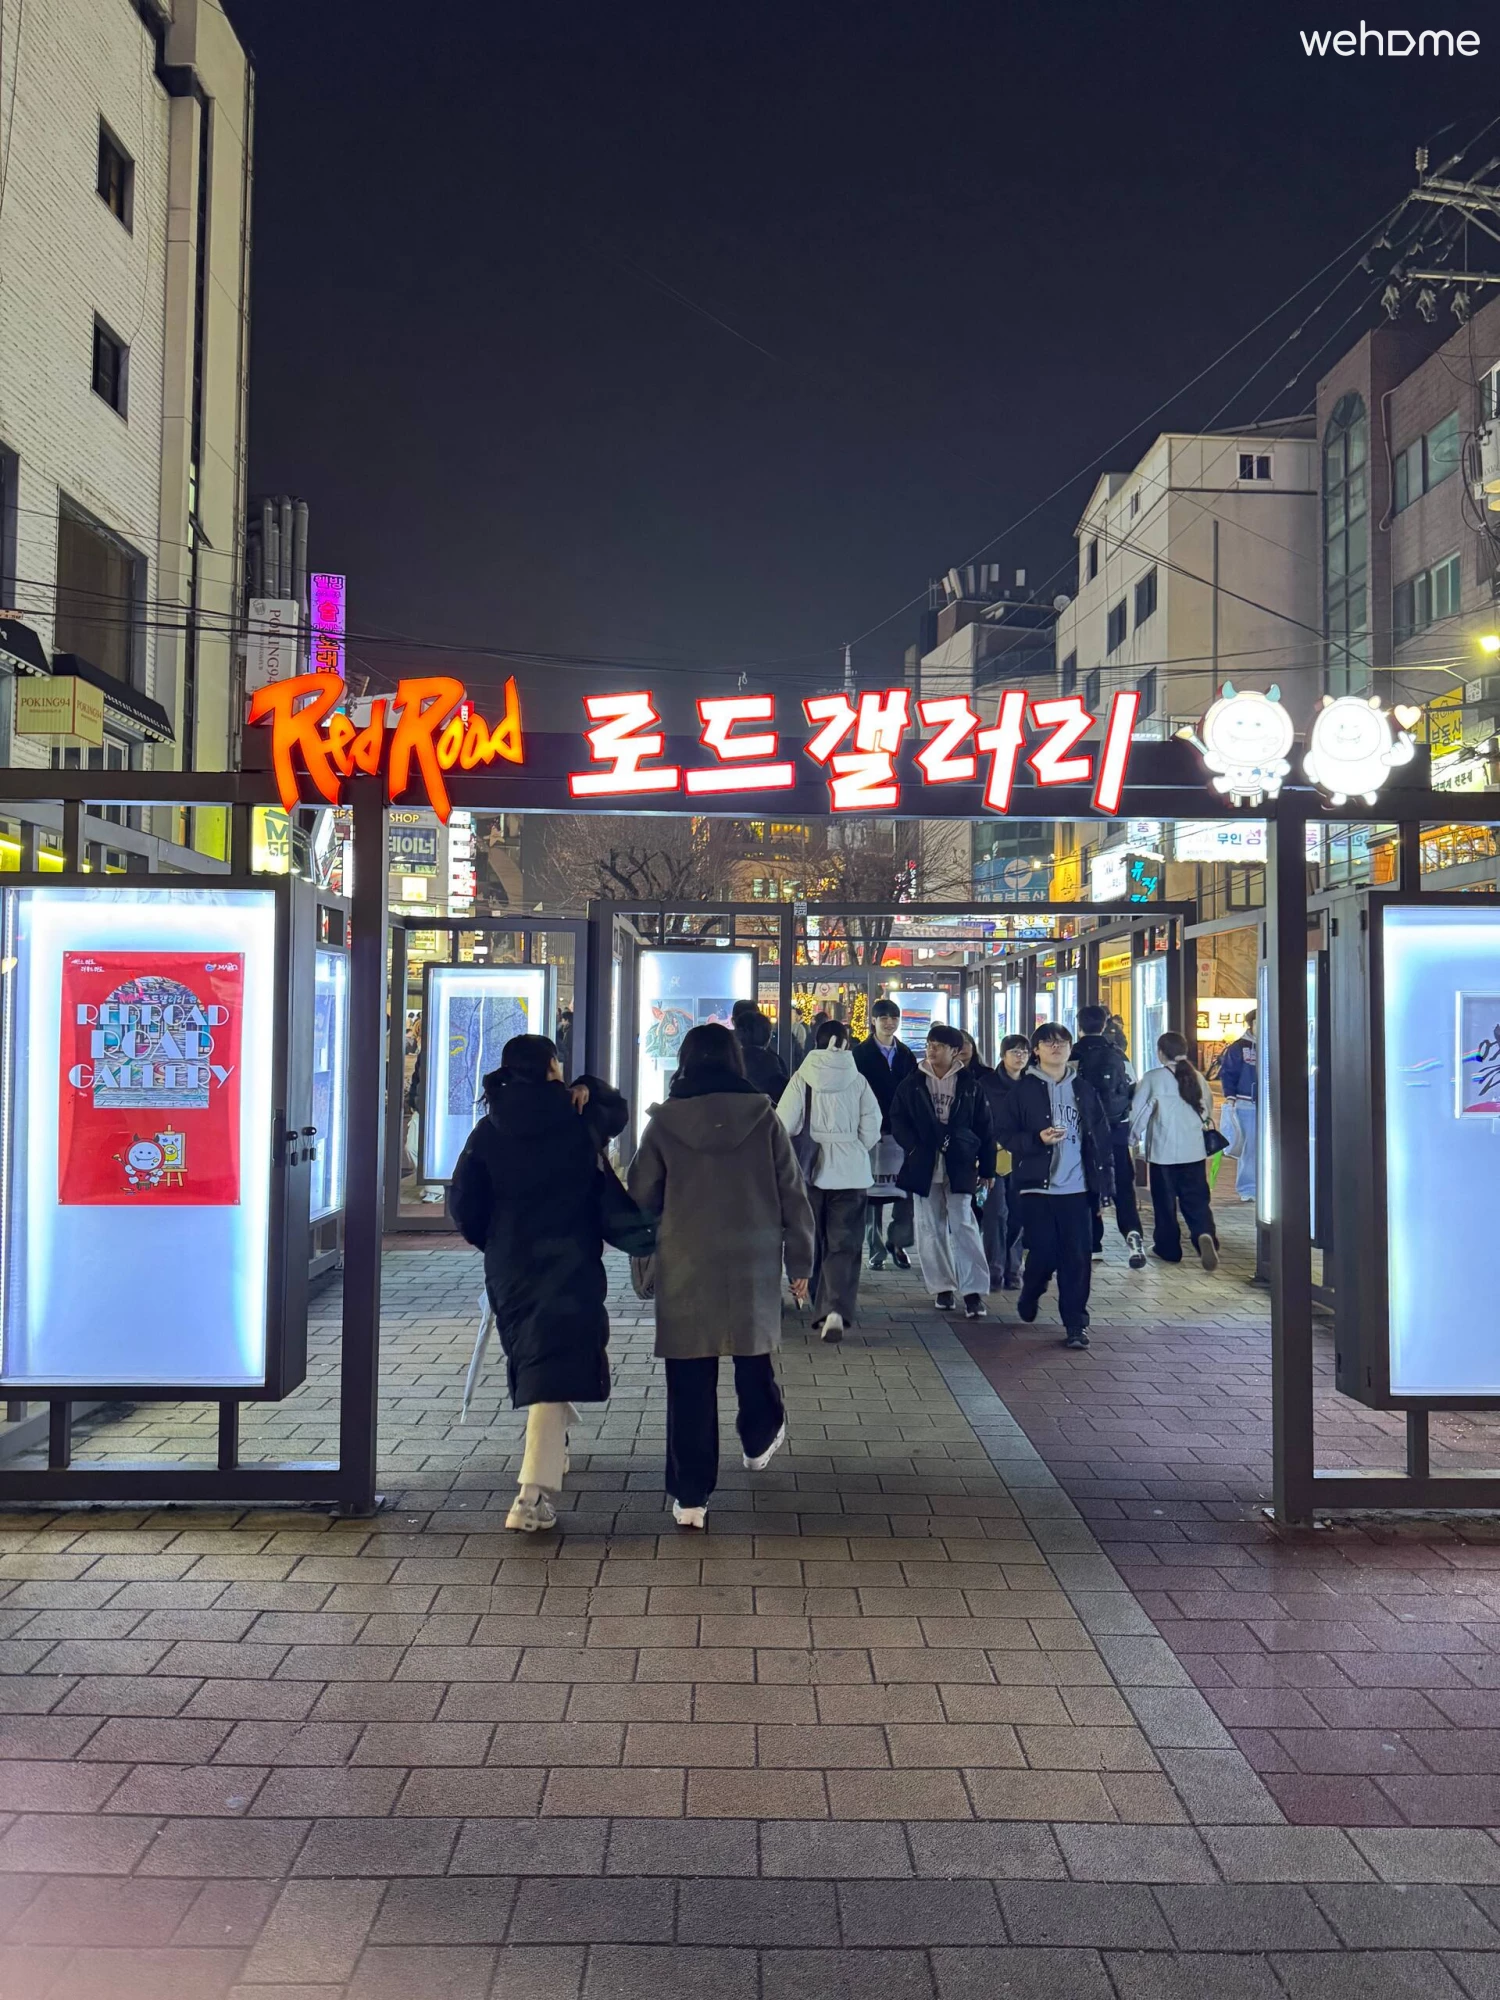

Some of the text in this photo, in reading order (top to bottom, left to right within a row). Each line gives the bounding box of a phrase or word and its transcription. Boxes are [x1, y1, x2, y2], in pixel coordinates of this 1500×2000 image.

[318, 600, 339, 623] 술
[21, 697, 70, 708] POKING94
[1431, 718, 1462, 751] 부동산
[247, 673, 524, 826] Red Road
[567, 686, 1142, 815] 로드갤러리
[1216, 832, 1242, 846] 무인
[77, 1003, 230, 1026] REDROAD
[91, 1029, 215, 1060] ROAD
[68, 1063, 236, 1089] GALLERY
